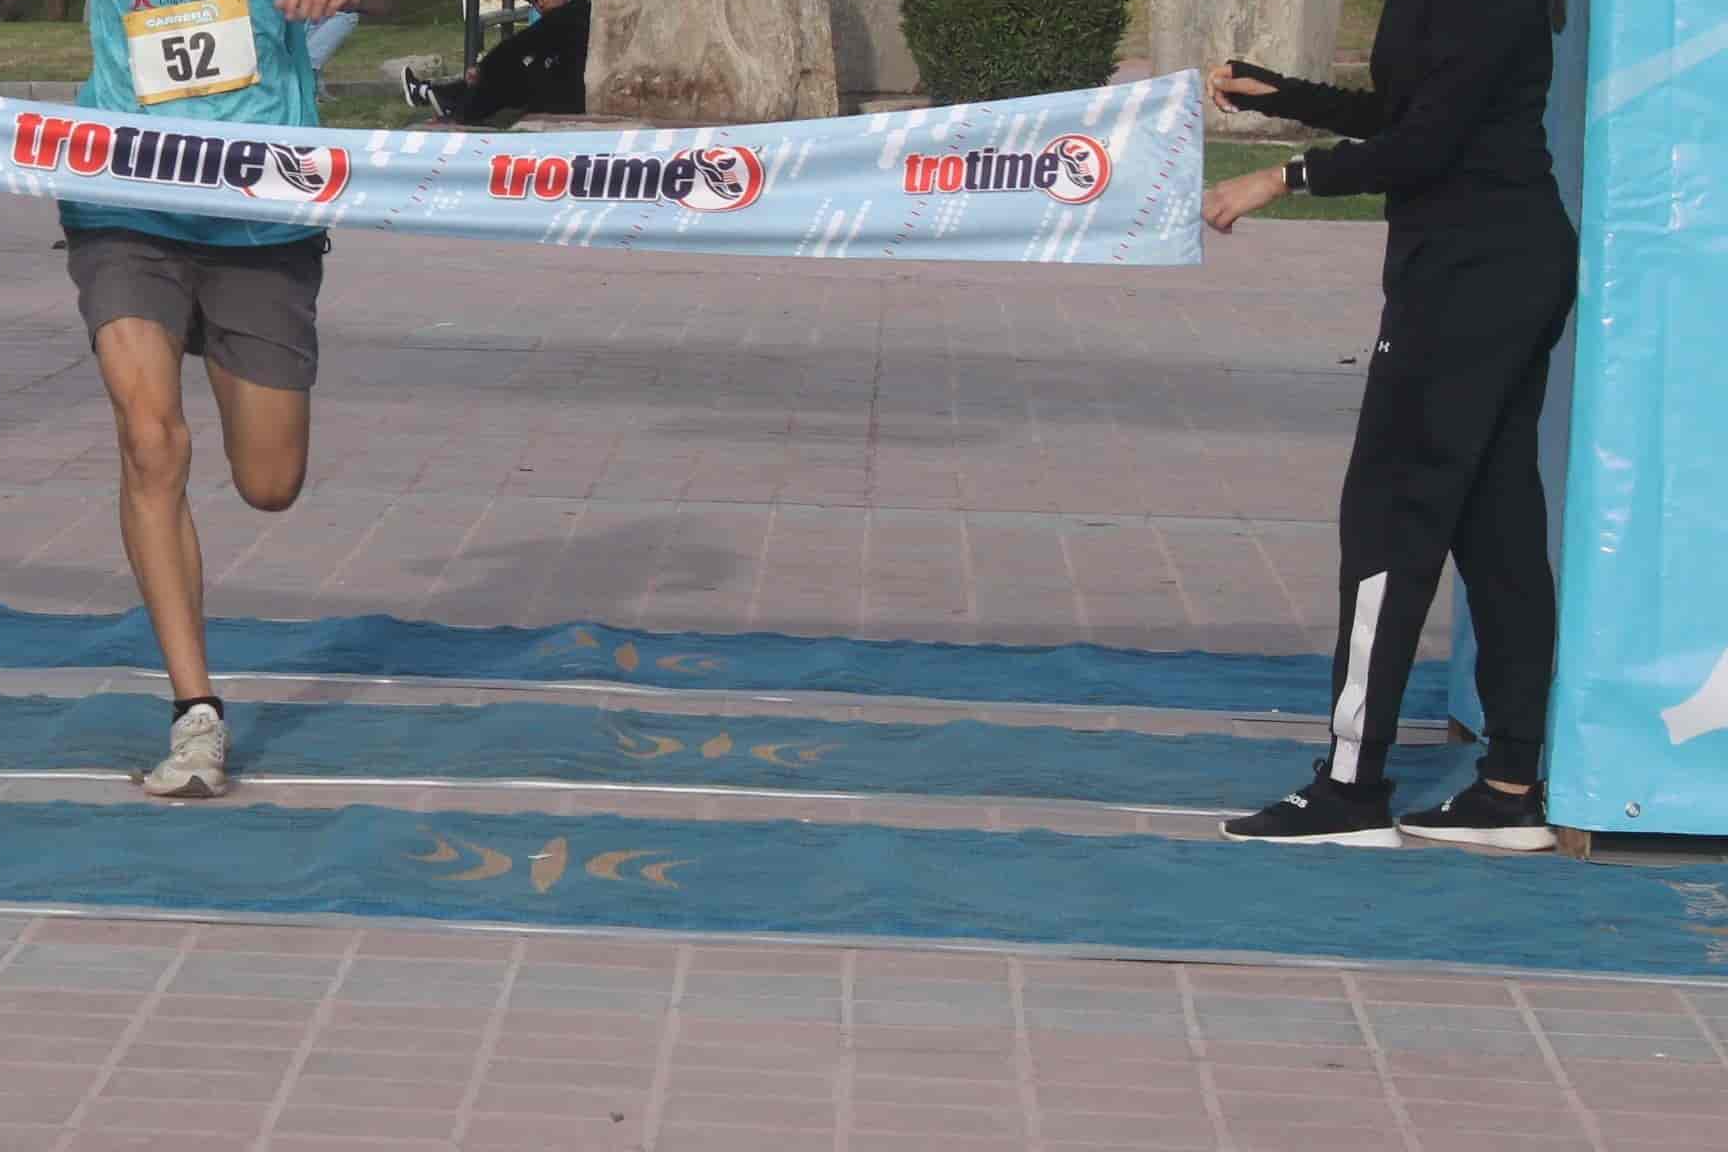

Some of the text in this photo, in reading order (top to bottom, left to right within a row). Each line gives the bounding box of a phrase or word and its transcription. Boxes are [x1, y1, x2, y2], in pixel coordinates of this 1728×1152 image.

[161, 31, 221, 83] 52
[12, 112, 271, 189] trotime
[903, 147, 1059, 193] trotime
[489, 152, 697, 200] trotime
